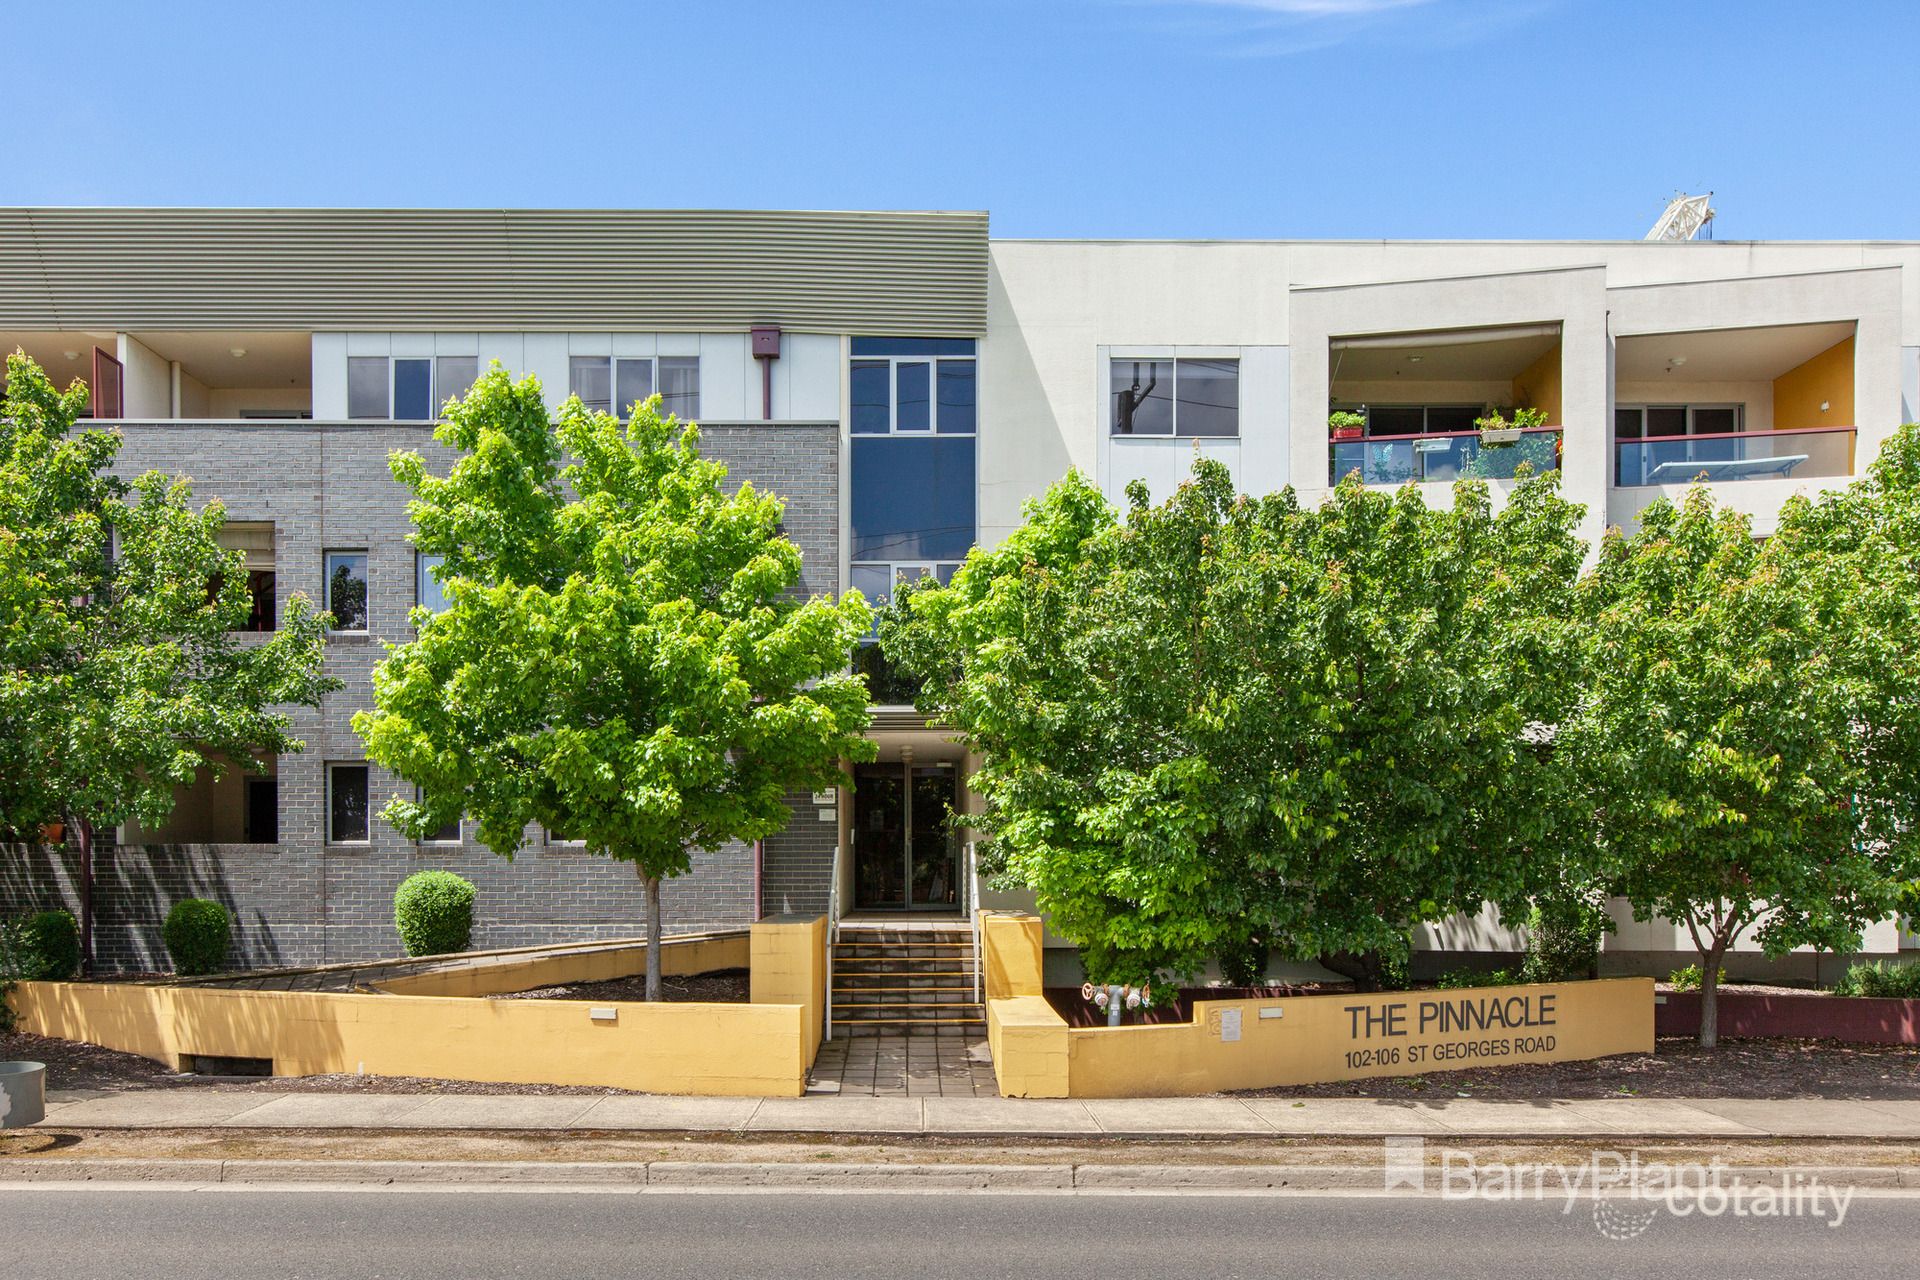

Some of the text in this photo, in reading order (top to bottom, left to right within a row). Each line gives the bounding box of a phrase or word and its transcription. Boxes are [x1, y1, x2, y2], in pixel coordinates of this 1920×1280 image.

[1344, 995, 1556, 1039] THE PINNACLE
[1345, 1035, 1556, 1068] 102-106 ST GEORGES ROAD
